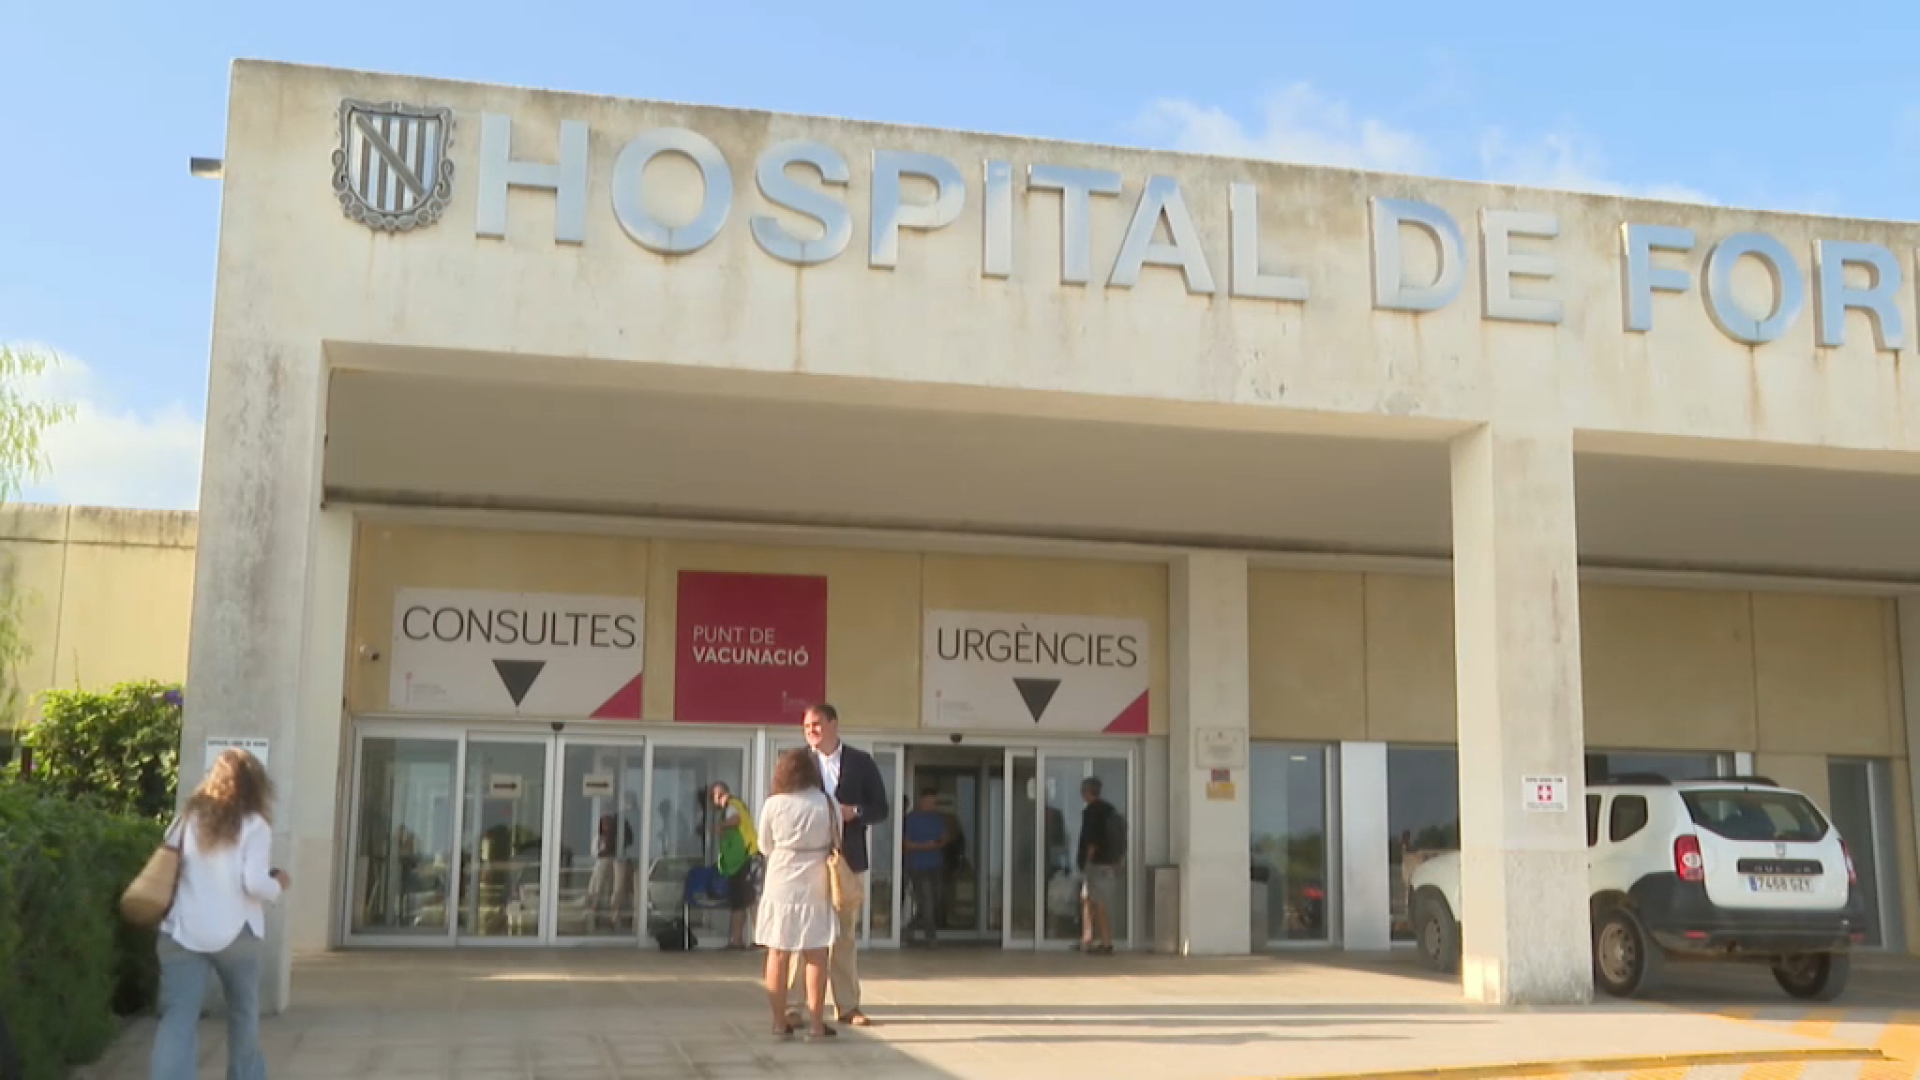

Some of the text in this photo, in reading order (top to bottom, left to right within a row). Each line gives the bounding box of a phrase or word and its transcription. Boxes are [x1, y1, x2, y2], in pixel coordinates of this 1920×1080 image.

[474, 112, 1920, 351] HOSPITAL DE FOR
[402, 605, 637, 649] CONSULTES
[693, 625, 776, 645] PUNT DE
[937, 622, 1138, 668] URGÈNCIES
[692, 645, 809, 666] VACUNACIÓ
